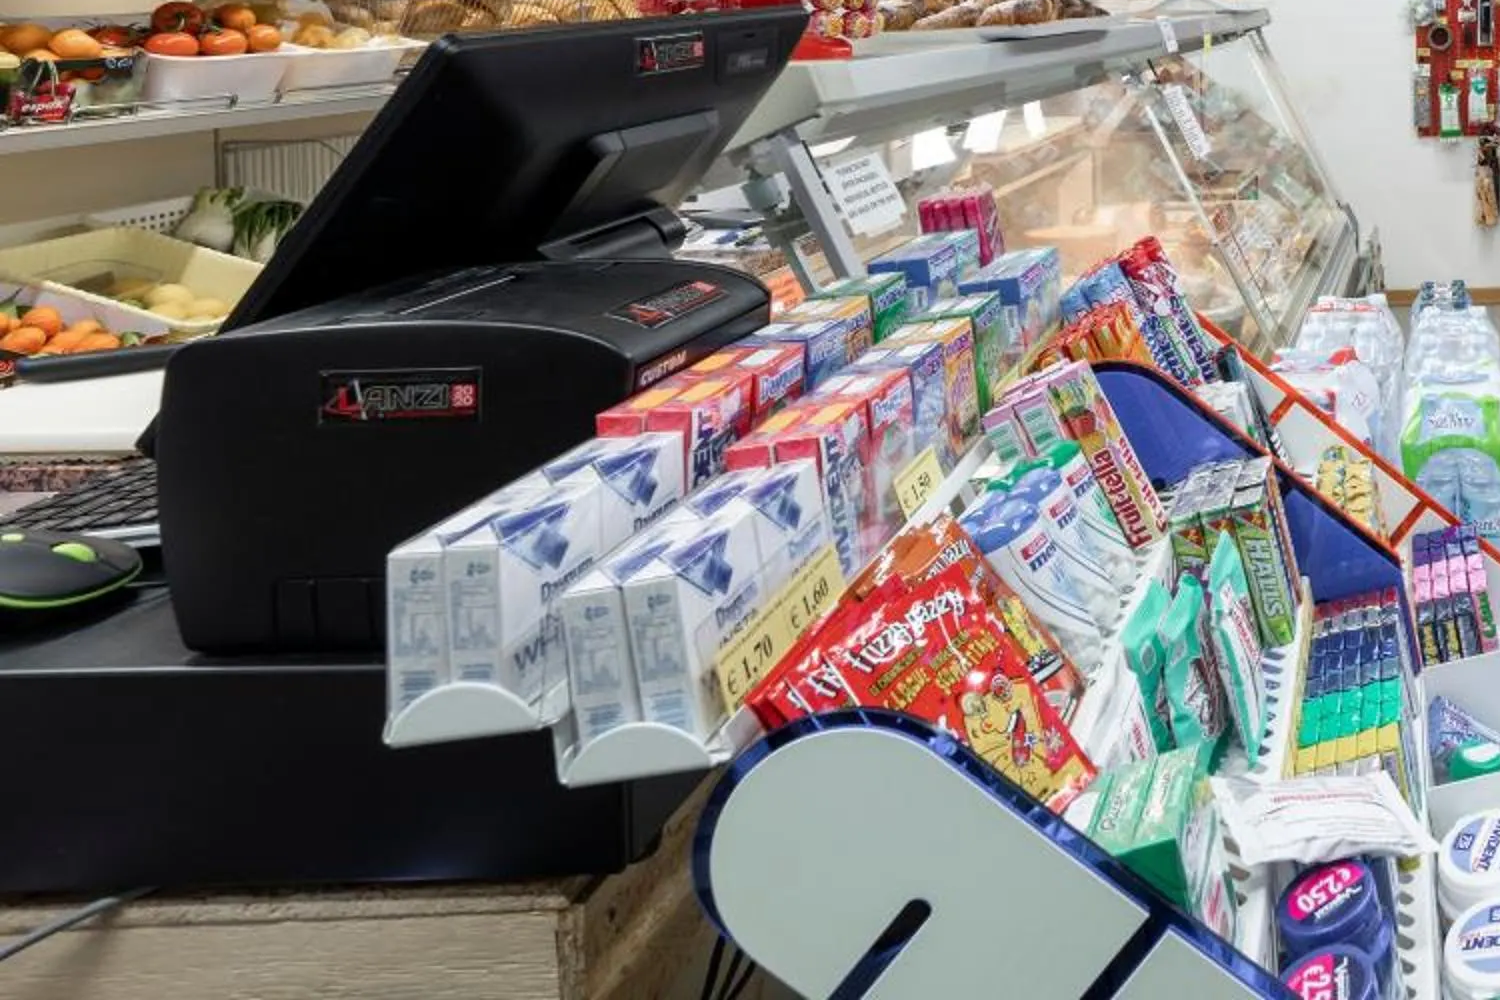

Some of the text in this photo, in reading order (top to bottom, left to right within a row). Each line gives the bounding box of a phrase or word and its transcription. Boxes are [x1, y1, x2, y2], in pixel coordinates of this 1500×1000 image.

[640, 350, 687, 386] CUSTOM
[1246, 538, 1284, 618] HALLS
[727, 634, 774, 695] € 1.70
